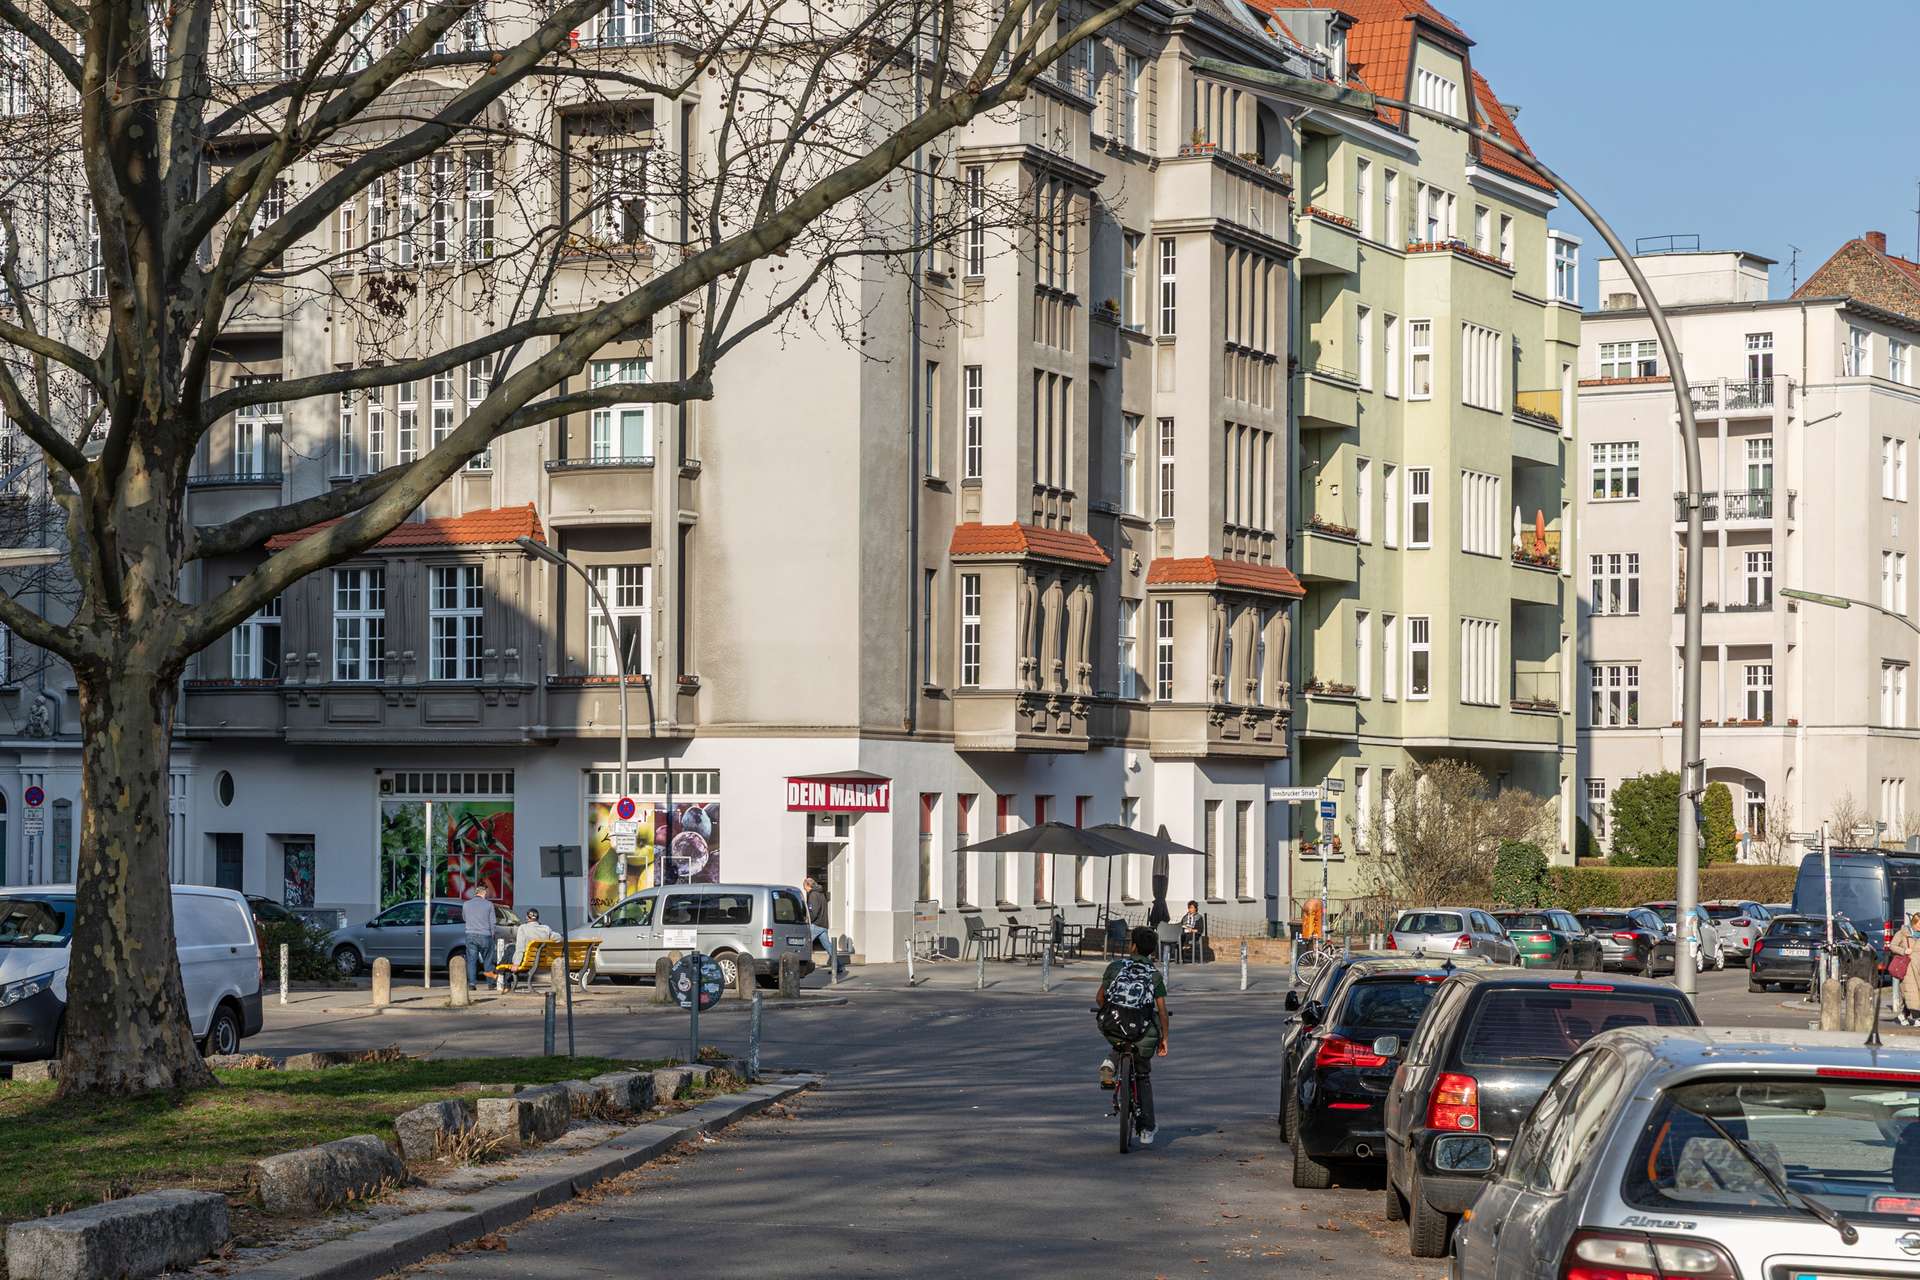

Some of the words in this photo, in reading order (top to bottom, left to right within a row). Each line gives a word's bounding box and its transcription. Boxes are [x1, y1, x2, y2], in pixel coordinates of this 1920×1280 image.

[788, 782, 826, 806] DEIN
[829, 783, 888, 807] MARKT
[1619, 1216, 1698, 1230] Almera
